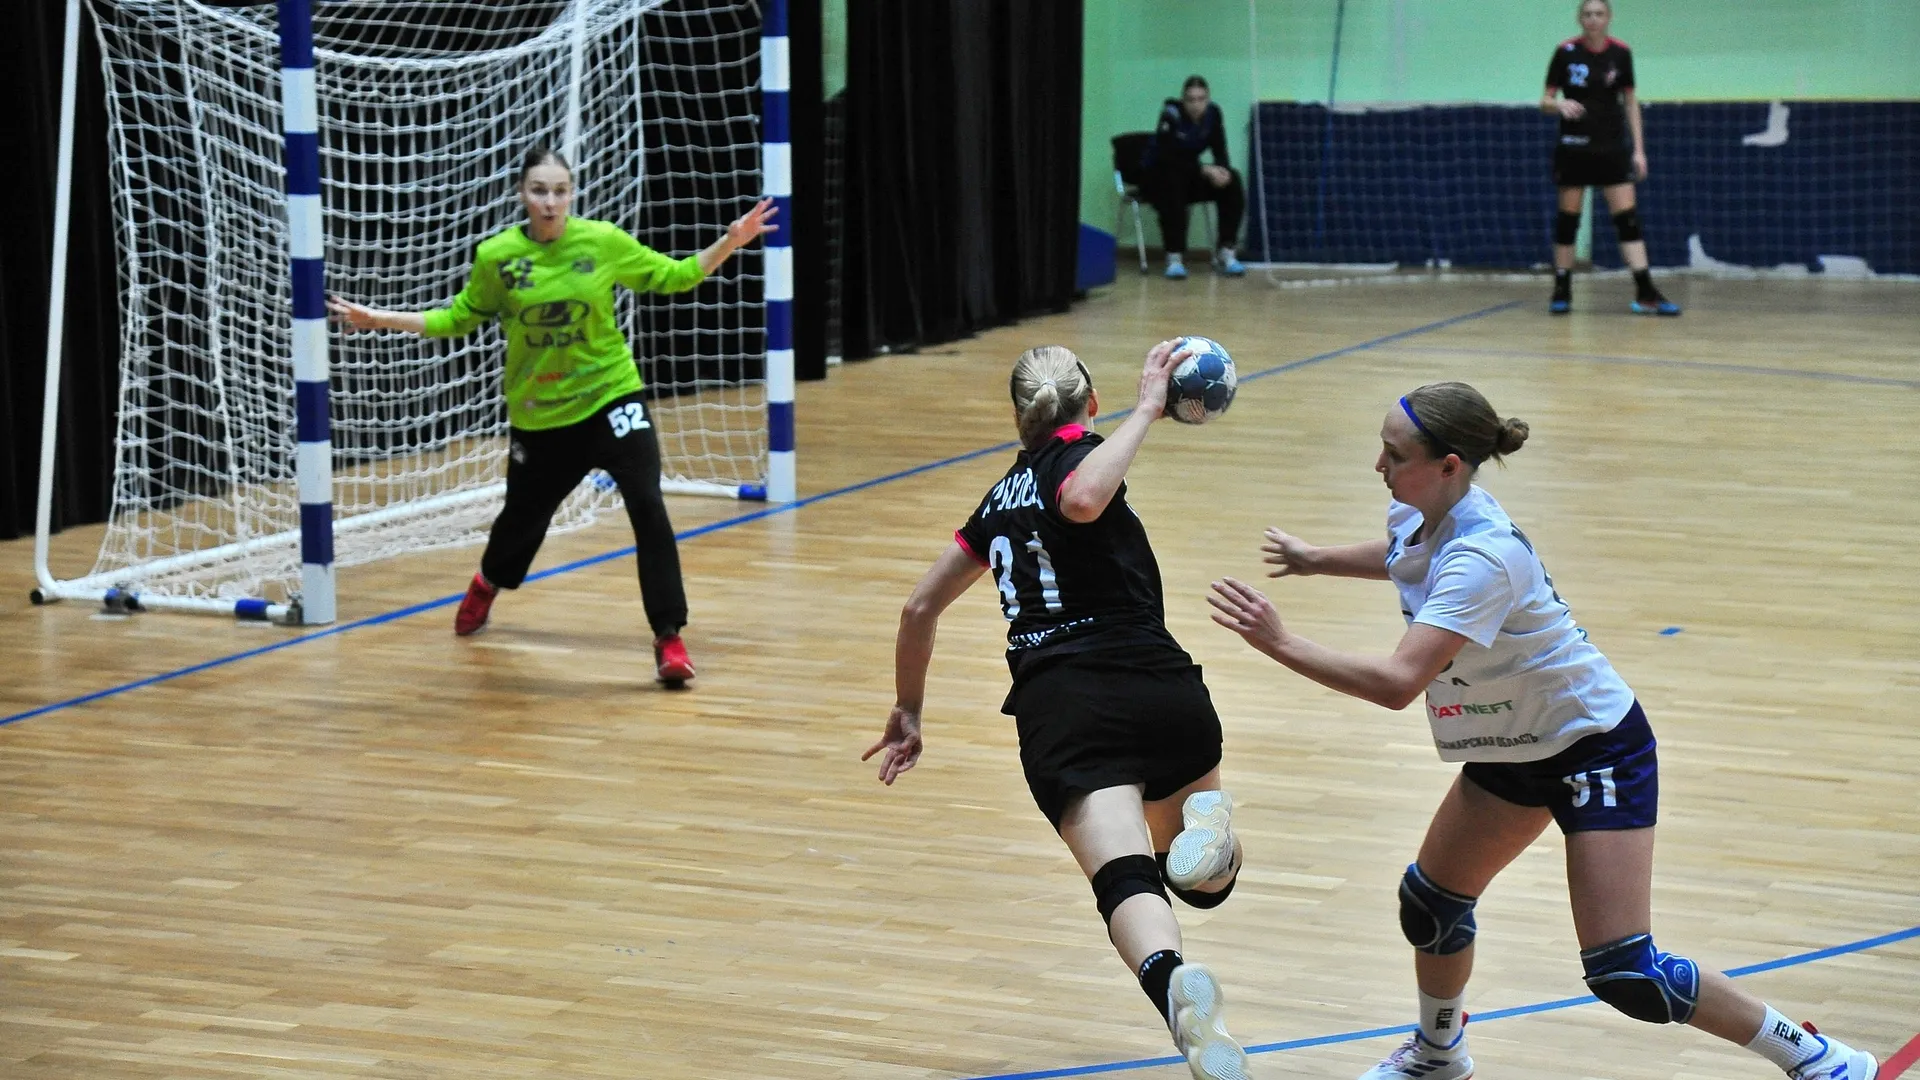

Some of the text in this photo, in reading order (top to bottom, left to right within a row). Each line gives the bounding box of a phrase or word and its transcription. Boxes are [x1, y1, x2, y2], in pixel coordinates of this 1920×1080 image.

[524, 327, 588, 350] LADA
[607, 402, 651, 438] 52
[989, 531, 1064, 623] 31
[1429, 699, 1513, 719] TATNEFT
[1773, 1019, 1803, 1047] KELME
